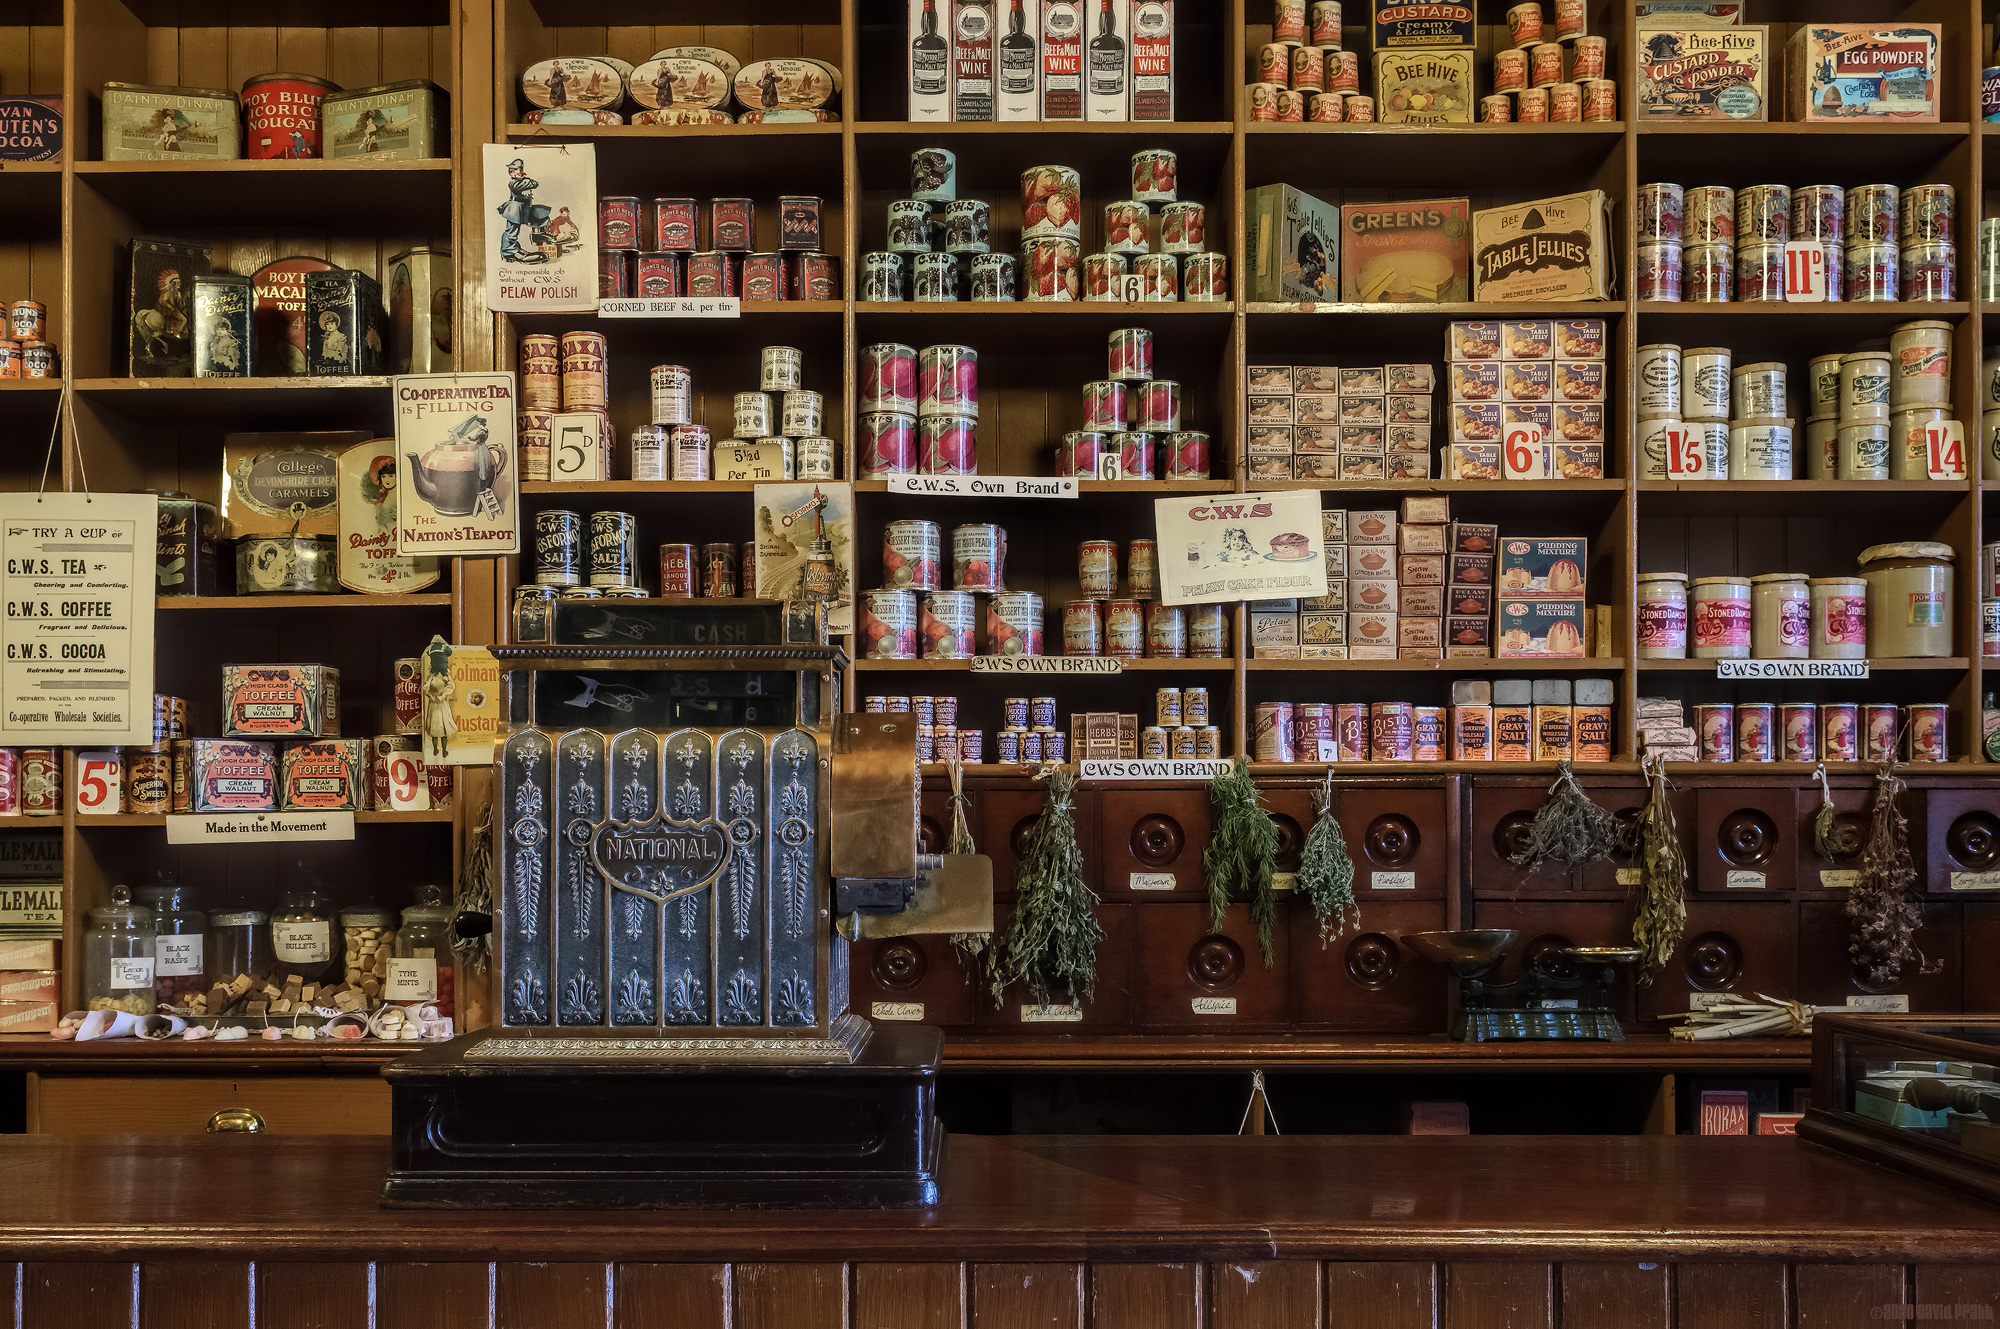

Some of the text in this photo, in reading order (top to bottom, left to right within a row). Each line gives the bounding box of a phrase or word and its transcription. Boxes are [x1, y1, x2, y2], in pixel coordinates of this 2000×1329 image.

[1381, 6, 1468, 20] CUSTARD
[1397, 21, 1454, 30] Creamy
[1049, 58, 1076, 71] WINE
[1139, 58, 1165, 71] WINE
[1844, 51, 1924, 65] EGG POWDER
[960, 61, 987, 74] WINE
[1395, 62, 1459, 83] BEE HIVE
[1653, 53, 1720, 81] CUSTARD
[113, 92, 224, 110] DAINTY DINAH
[328, 92, 414, 115] DAINTY DINAH
[1349, 207, 1441, 233] GREEN'S
[1501, 206, 1565, 229] BEE HIVE
[1484, 236, 1585, 278] TABLE JELLIES
[501, 286, 578, 299] PELAW POLISH
[604, 303, 714, 313] CORNED BEEF per
[563, 341, 603, 359] SAXA
[315, 365, 349, 374] TOFFEE
[563, 360, 603, 373] SALT
[487, 385, 512, 399] TEA
[402, 401, 494, 419] IS FILLING
[753, 467, 771, 478] Tin
[255, 476, 309, 487] DEVONSHIRE
[906, 478, 1060, 494] C.W.S. Own Brand
[269, 488, 330, 498] CARAMELS
[413, 516, 437, 525] THE
[32, 527, 107, 538] TRY A CUP
[403, 527, 515, 542] NATION'S TEAPOT
[544, 553, 573, 563] SALT
[593, 553, 620, 564] SALT
[8, 559, 87, 575] C.W.S. TEA
[1227, 578, 1264, 590] CAKE
[8, 601, 112, 617] C.W.S. COFFEE
[1709, 607, 1735, 618] STONED
[694, 624, 747, 643] CASH
[8, 643, 106, 659] C.W.S. COCOA
[975, 658, 1121, 672] CWS OWN BRAND
[1720, 664, 1866, 676] CWS OWN BRAND
[450, 663, 500, 682] Colman'
[243, 691, 296, 700] TOFFEE
[9, 711, 123, 723] Co-operative Wholesale Societies.
[1090, 729, 1117, 738] HERBS
[1373, 717, 1408, 740] BISTO
[1415, 724, 1443, 732] GRAVY
[1499, 723, 1529, 732] GRAVY
[1579, 723, 1609, 731] GRAVY
[1418, 733, 1441, 741] SALT
[1502, 732, 1526, 741] SALT
[1581, 732, 1606, 740] SALT
[215, 766, 265, 775] TOFFEE
[298, 765, 341, 774] TOFFEE
[1085, 763, 1230, 776] CWS OWN BRAND
[206, 821, 327, 833] Made in the Movement
[606, 837, 717, 860] NATIONAL
[1705, 1105, 1745, 1135] BORAX
